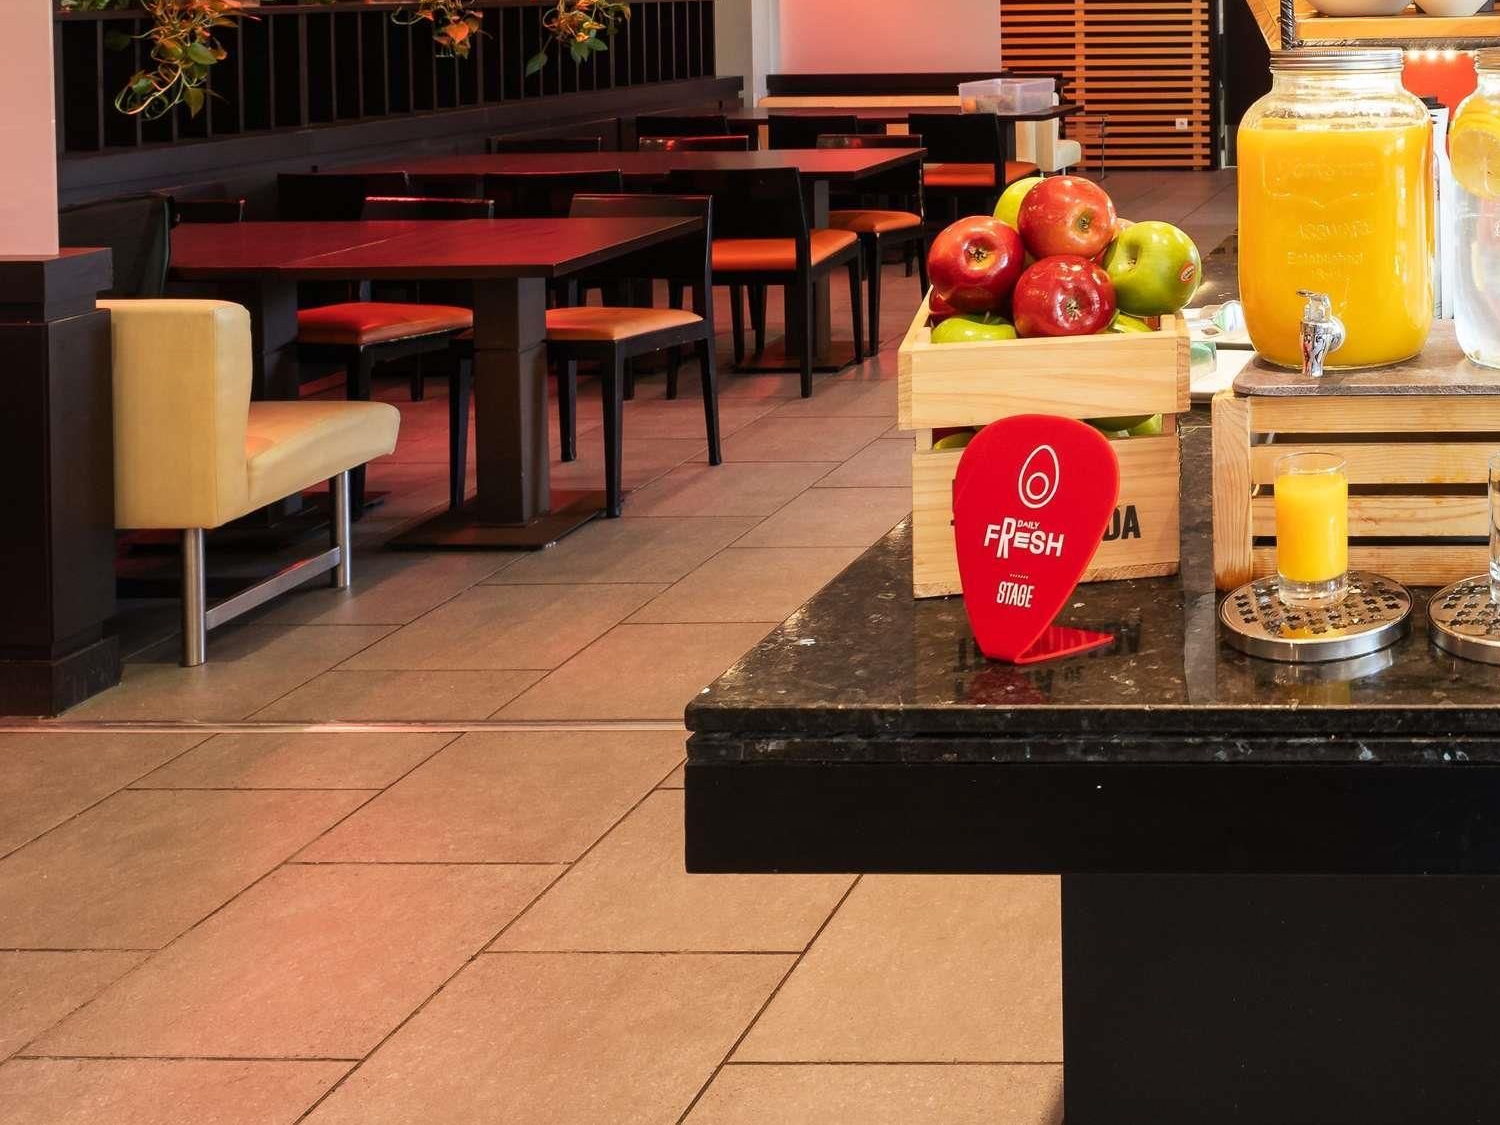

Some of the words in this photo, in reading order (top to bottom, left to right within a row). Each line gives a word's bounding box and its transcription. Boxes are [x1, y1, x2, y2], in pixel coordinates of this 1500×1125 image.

[984, 516, 1065, 559] FRESH
[1017, 519, 1041, 530] DAILY
[996, 580, 1036, 608] STAGE
